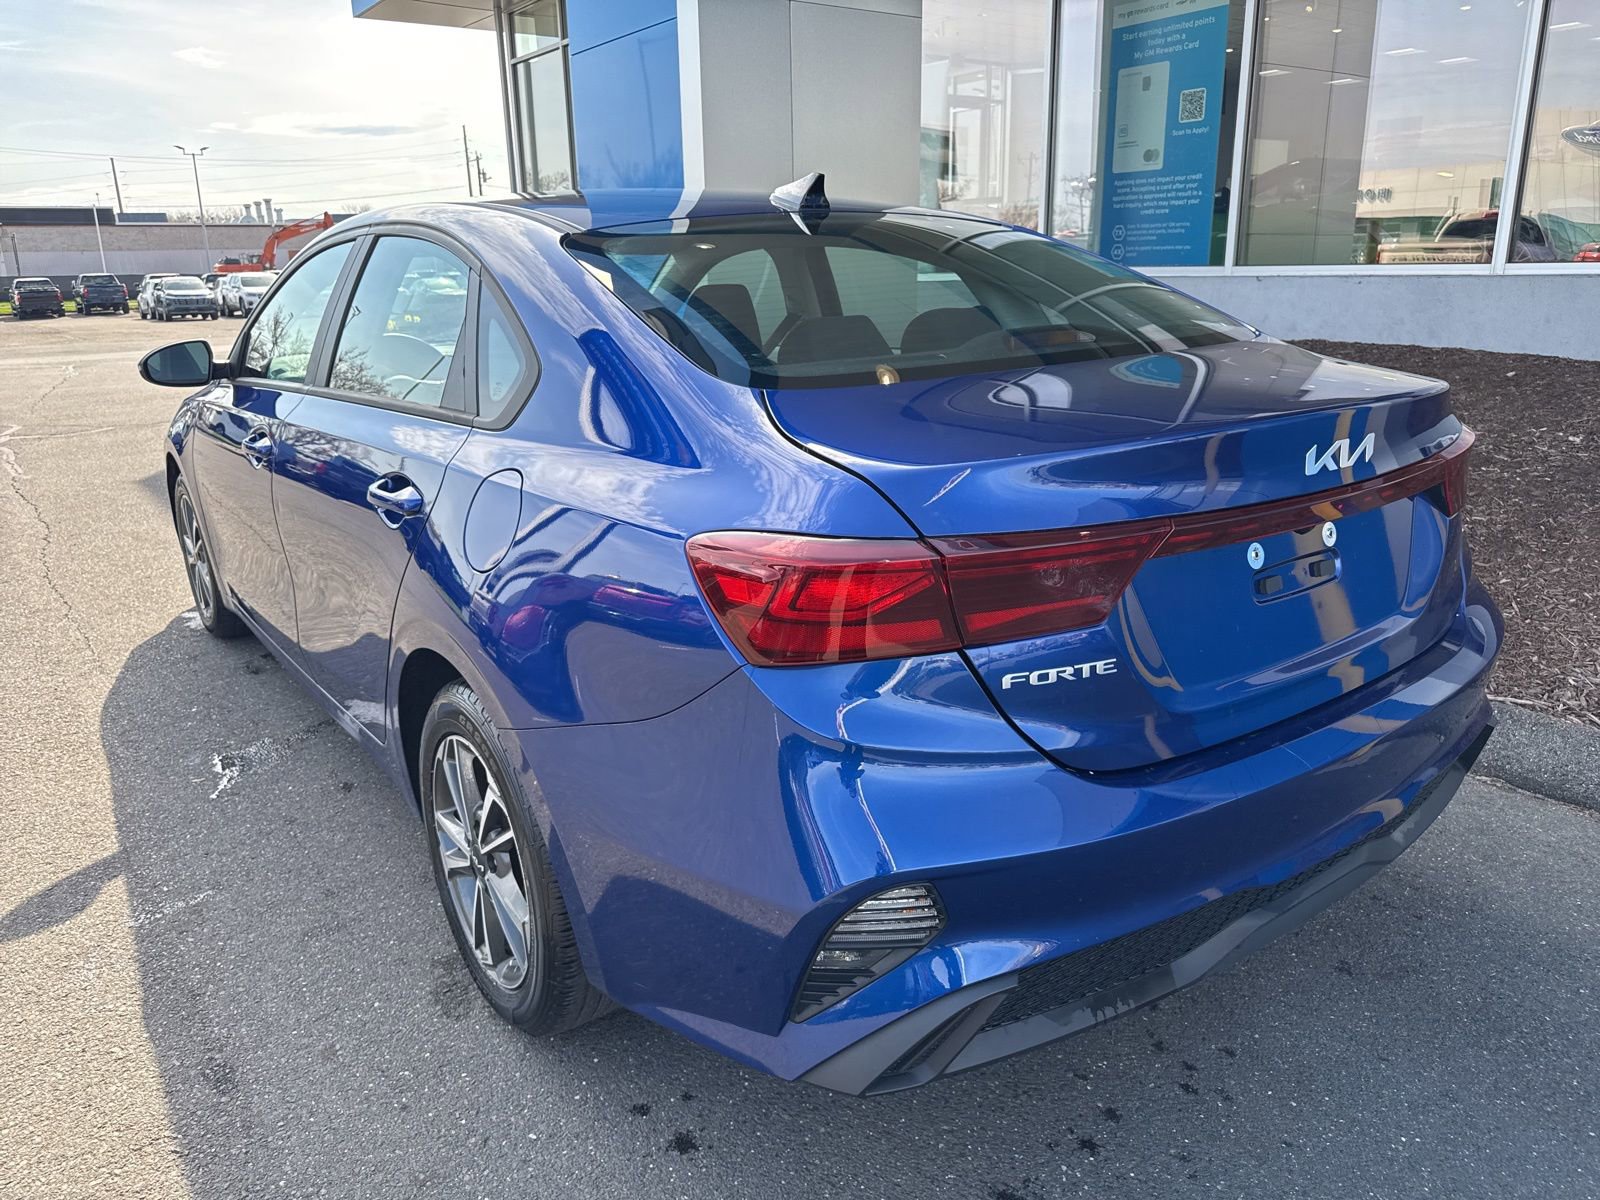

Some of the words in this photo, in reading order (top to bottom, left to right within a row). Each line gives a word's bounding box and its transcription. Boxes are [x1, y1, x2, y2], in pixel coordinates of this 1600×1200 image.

[1122, 32, 1138, 40] Start
[1138, 28, 1162, 38] earning
[1163, 20, 1194, 32] unlimited
[1194, 16, 1215, 28] points
[1166, 34, 1180, 42] with
[1134, 51, 1144, 60] My
[1144, 48, 1154, 56] GM
[1156, 44, 1182, 55] Rewards
[1183, 40, 1200, 50] Card
[1305, 432, 1375, 476] KIA
[1002, 658, 1117, 690] FORTE
